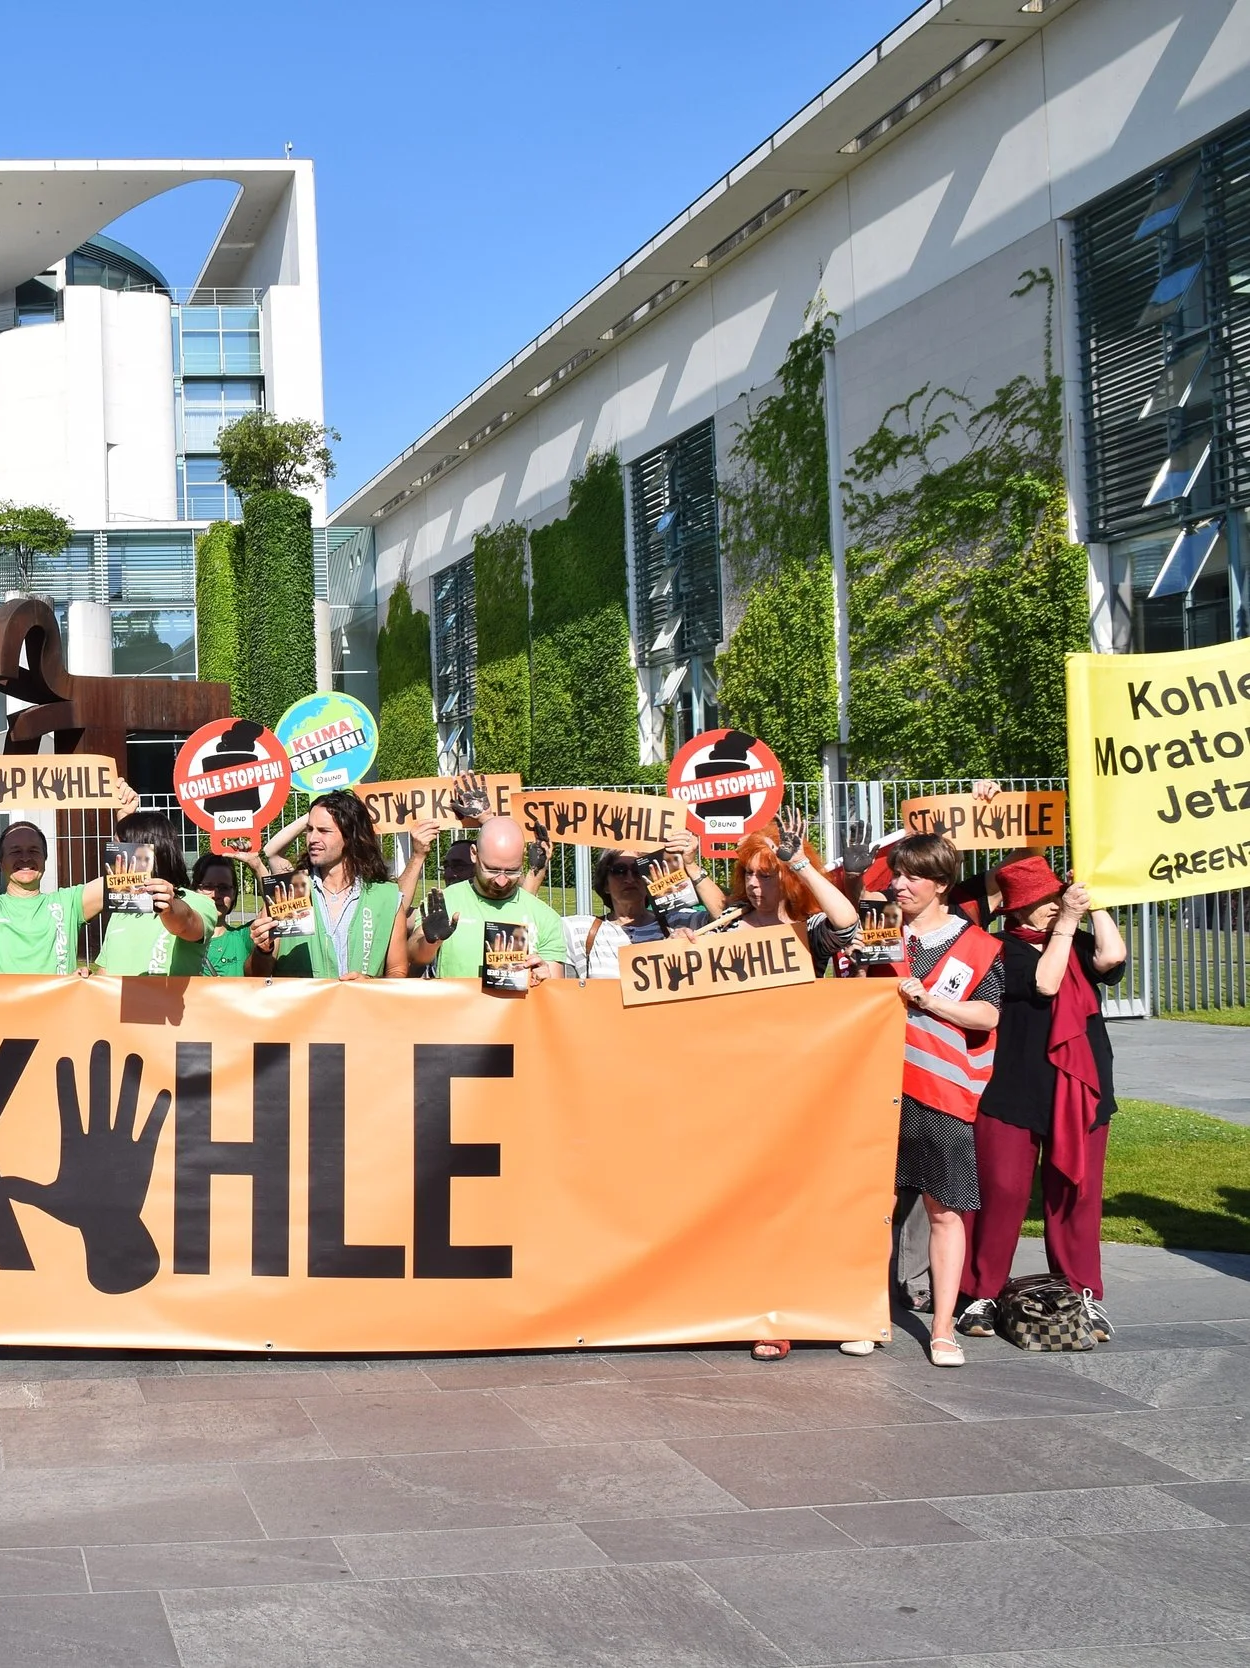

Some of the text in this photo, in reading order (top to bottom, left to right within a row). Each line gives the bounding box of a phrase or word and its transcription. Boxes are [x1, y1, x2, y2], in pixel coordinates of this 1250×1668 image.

[290, 730, 366, 772] RETTEN!
[292, 720, 352, 753] KLIMA
[1095, 726, 1250, 776] Morato
[179, 760, 284, 801] KOHLE STOPPEN!
[671, 770, 776, 801] KOHLE STOPPEN!
[1157, 778, 1250, 824] Jetz
